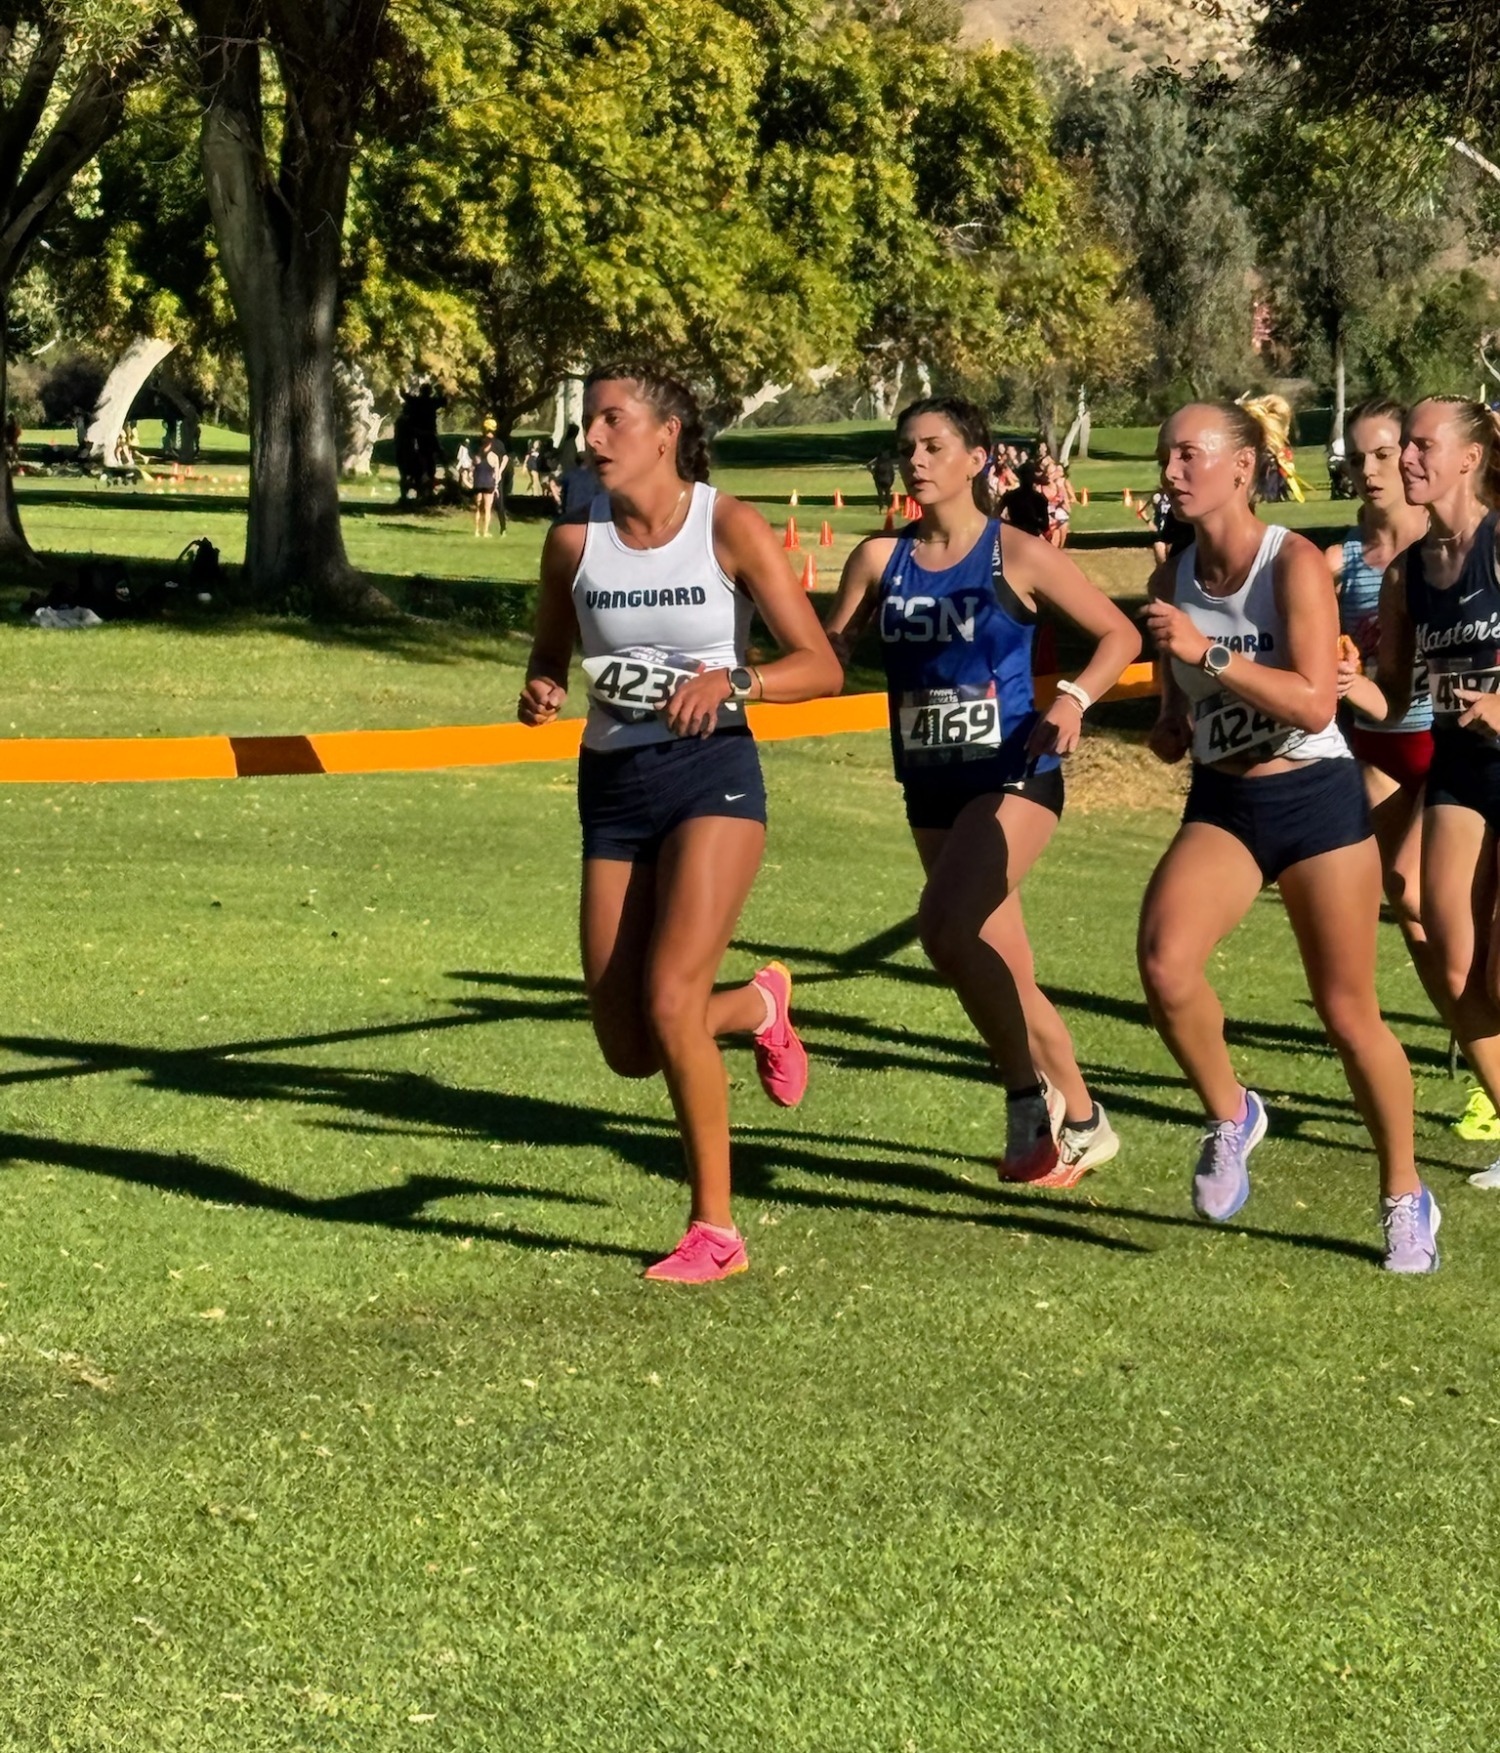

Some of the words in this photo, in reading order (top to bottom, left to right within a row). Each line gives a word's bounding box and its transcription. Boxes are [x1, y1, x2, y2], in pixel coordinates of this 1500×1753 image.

[586, 586, 706, 610] VANGUARD
[881, 595, 979, 643] CSN
[594, 661, 692, 704] 423
[910, 703, 995, 746] 4169
[1208, 707, 1276, 753] 424
